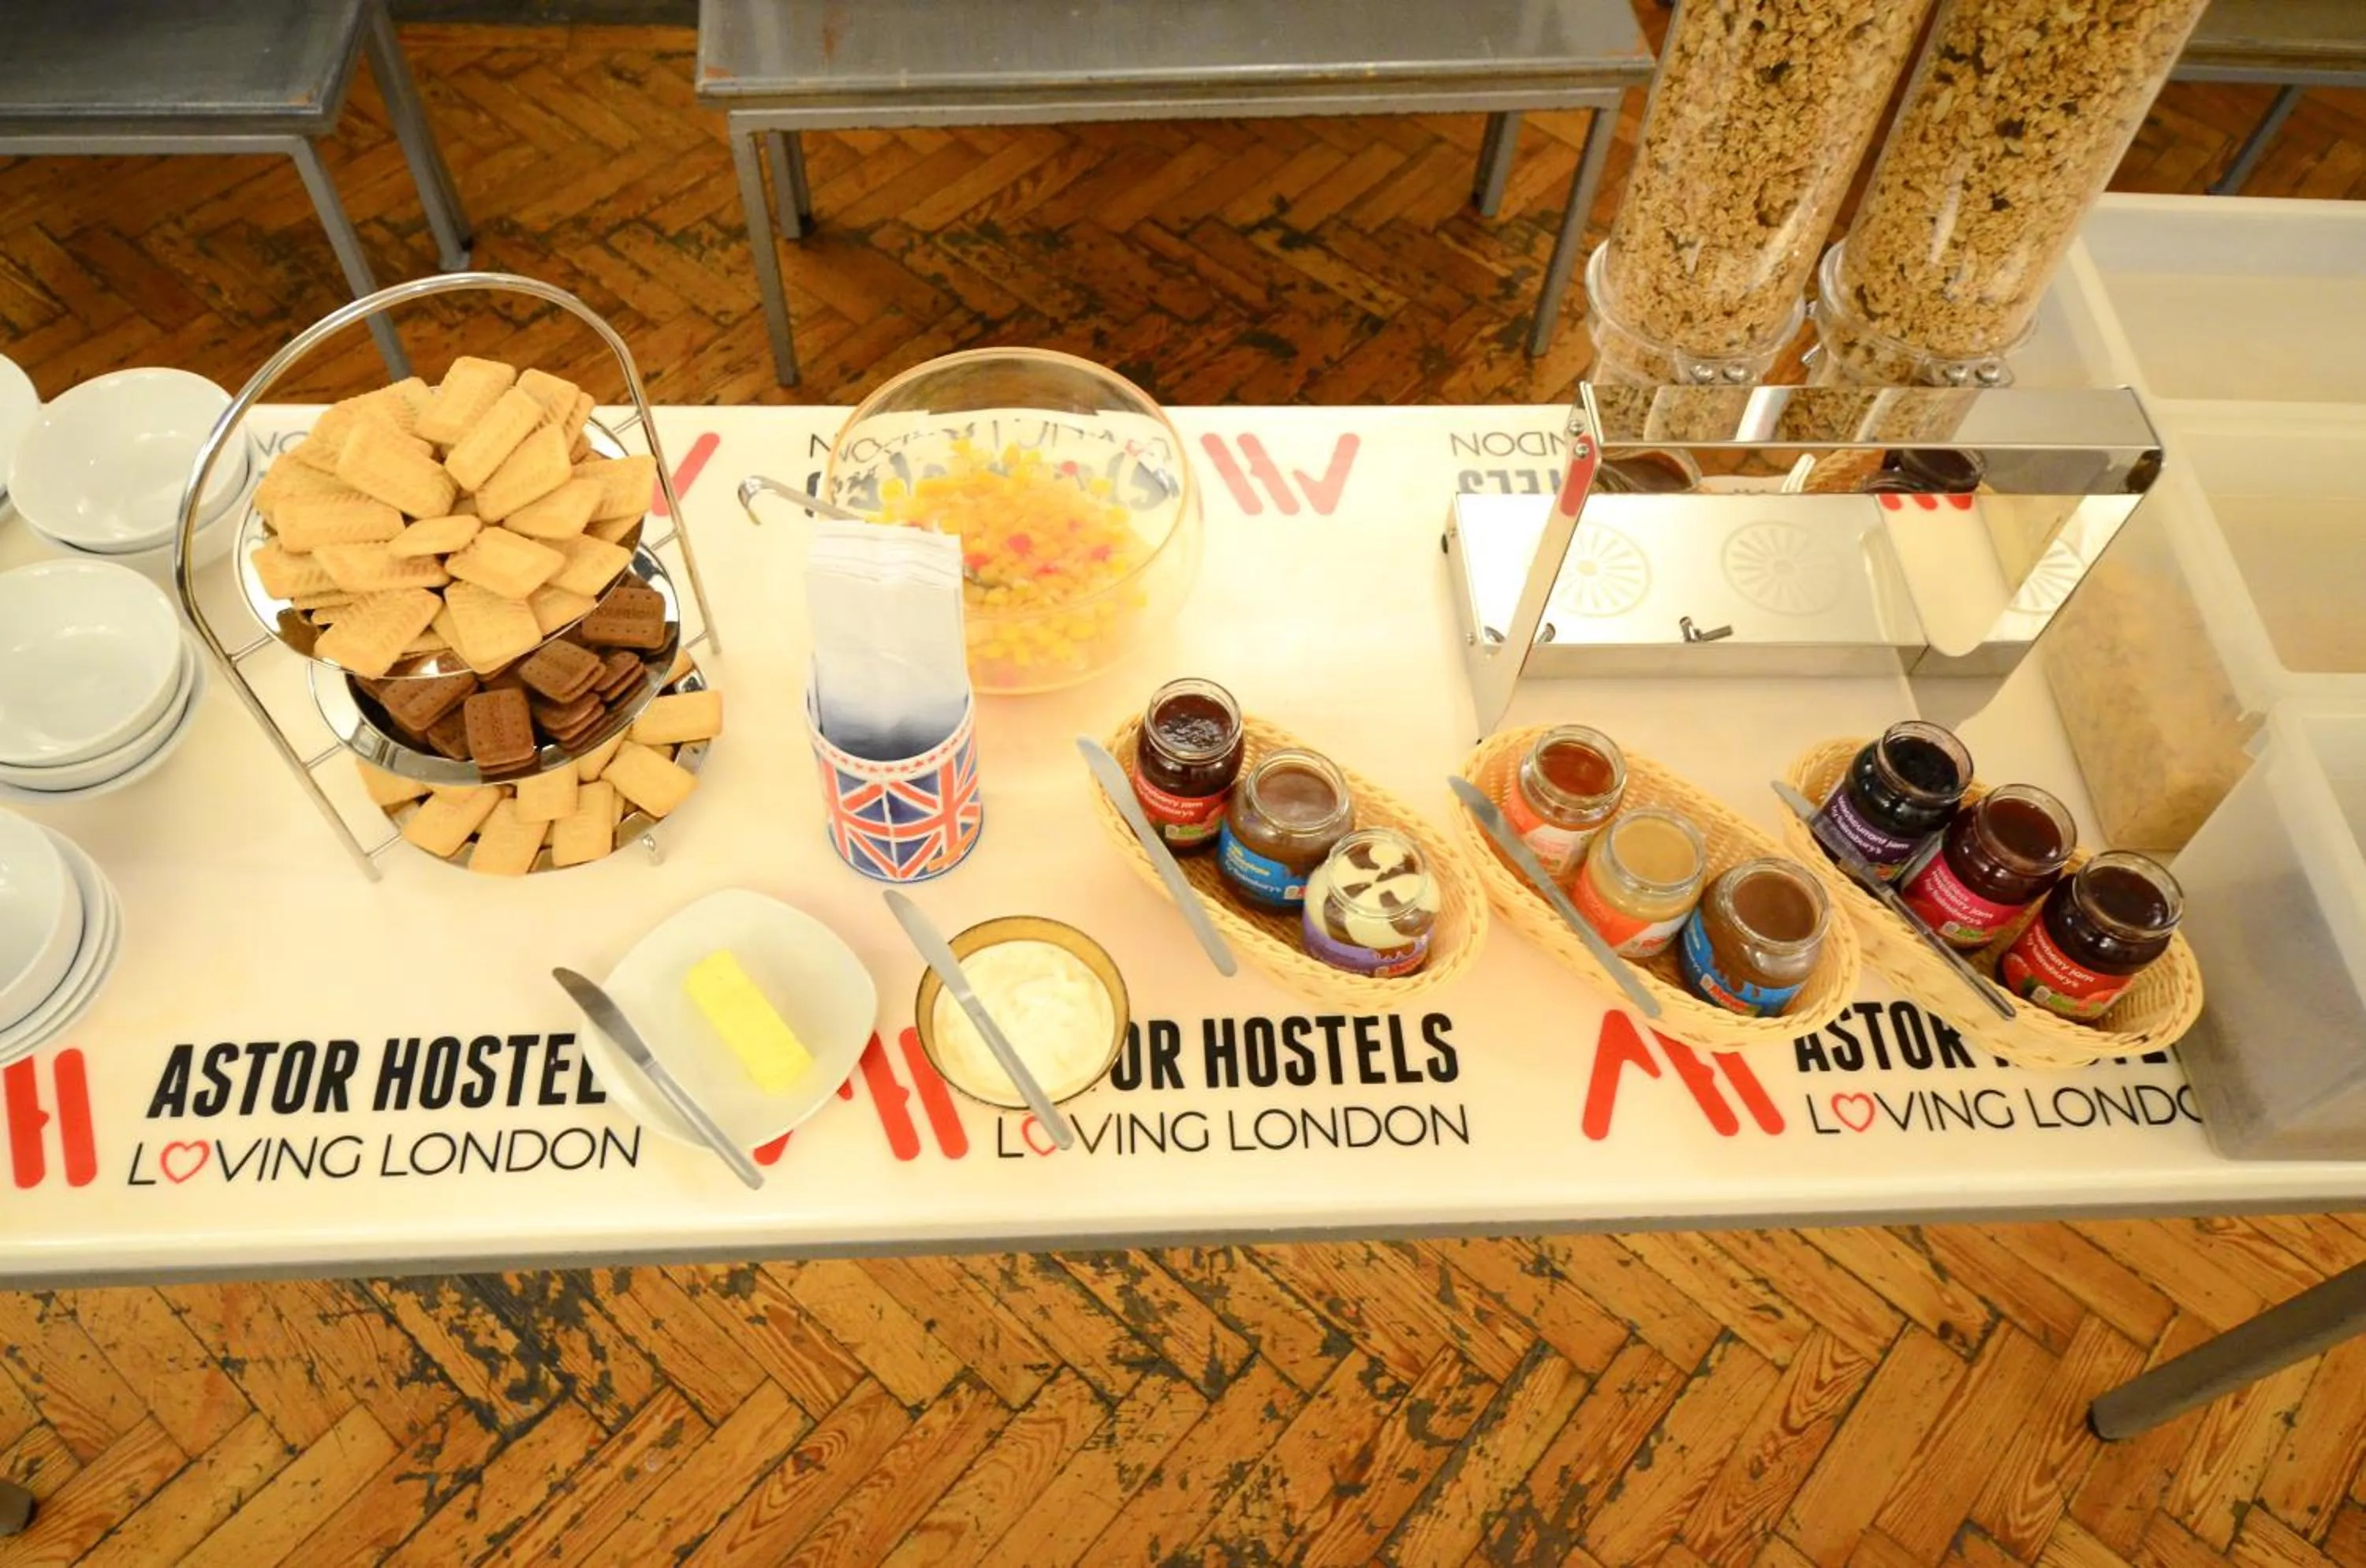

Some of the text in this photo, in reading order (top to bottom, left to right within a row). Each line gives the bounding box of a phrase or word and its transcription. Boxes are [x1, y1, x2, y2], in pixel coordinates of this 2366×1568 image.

[1450, 431, 1566, 457] NDON
[1204, 1013, 1458, 1088] HOSTELS
[1794, 1001, 1976, 1072] ASTOR
[147, 1033, 606, 1118] ASTOR HOSTEL
[1229, 1105, 1469, 1151] LONDON
[2025, 1083, 2205, 1128] LONDO
[381, 1126, 640, 1177] LONDON
